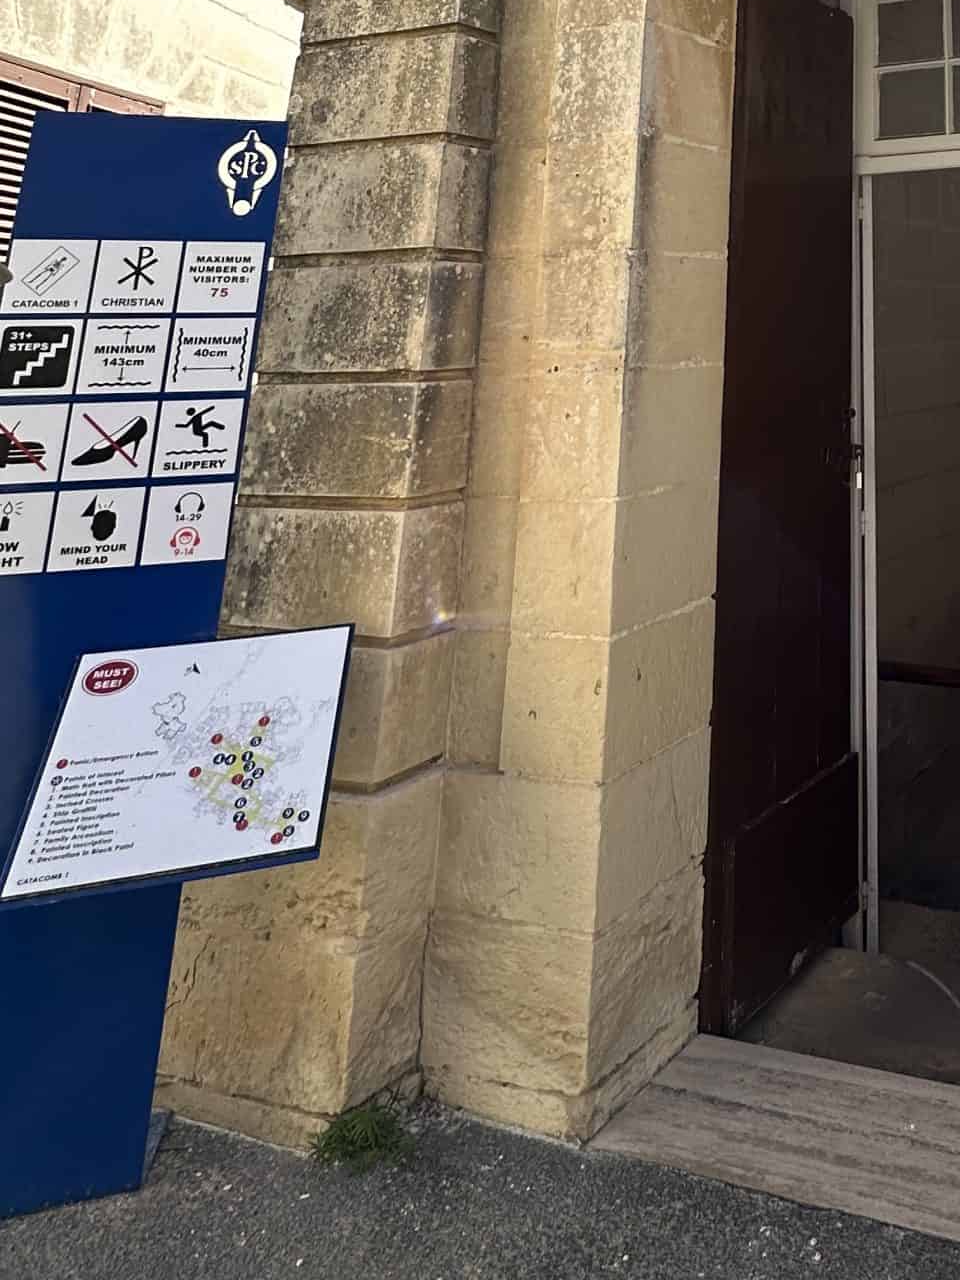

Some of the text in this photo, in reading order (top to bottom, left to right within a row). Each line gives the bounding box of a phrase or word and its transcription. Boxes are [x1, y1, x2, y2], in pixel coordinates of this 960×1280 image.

[211, 288, 229, 297] 75
[12, 299, 78, 308] CATACOMB 1
[101, 298, 164, 307] CHRISTIAN
[10, 331, 33, 340] 31+
[183, 336, 242, 345] MINIMUM
[8, 342, 49, 352] STEPS
[94, 345, 156, 354] MINIMUM
[193, 348, 228, 357] 40cm
[102, 358, 145, 367] 143cm
[163, 459, 226, 471] SLIPPERY
[60, 543, 127, 555] MIND YOUR
[76, 556, 108, 566] HEAD
[93, 667, 130, 679] MUST
